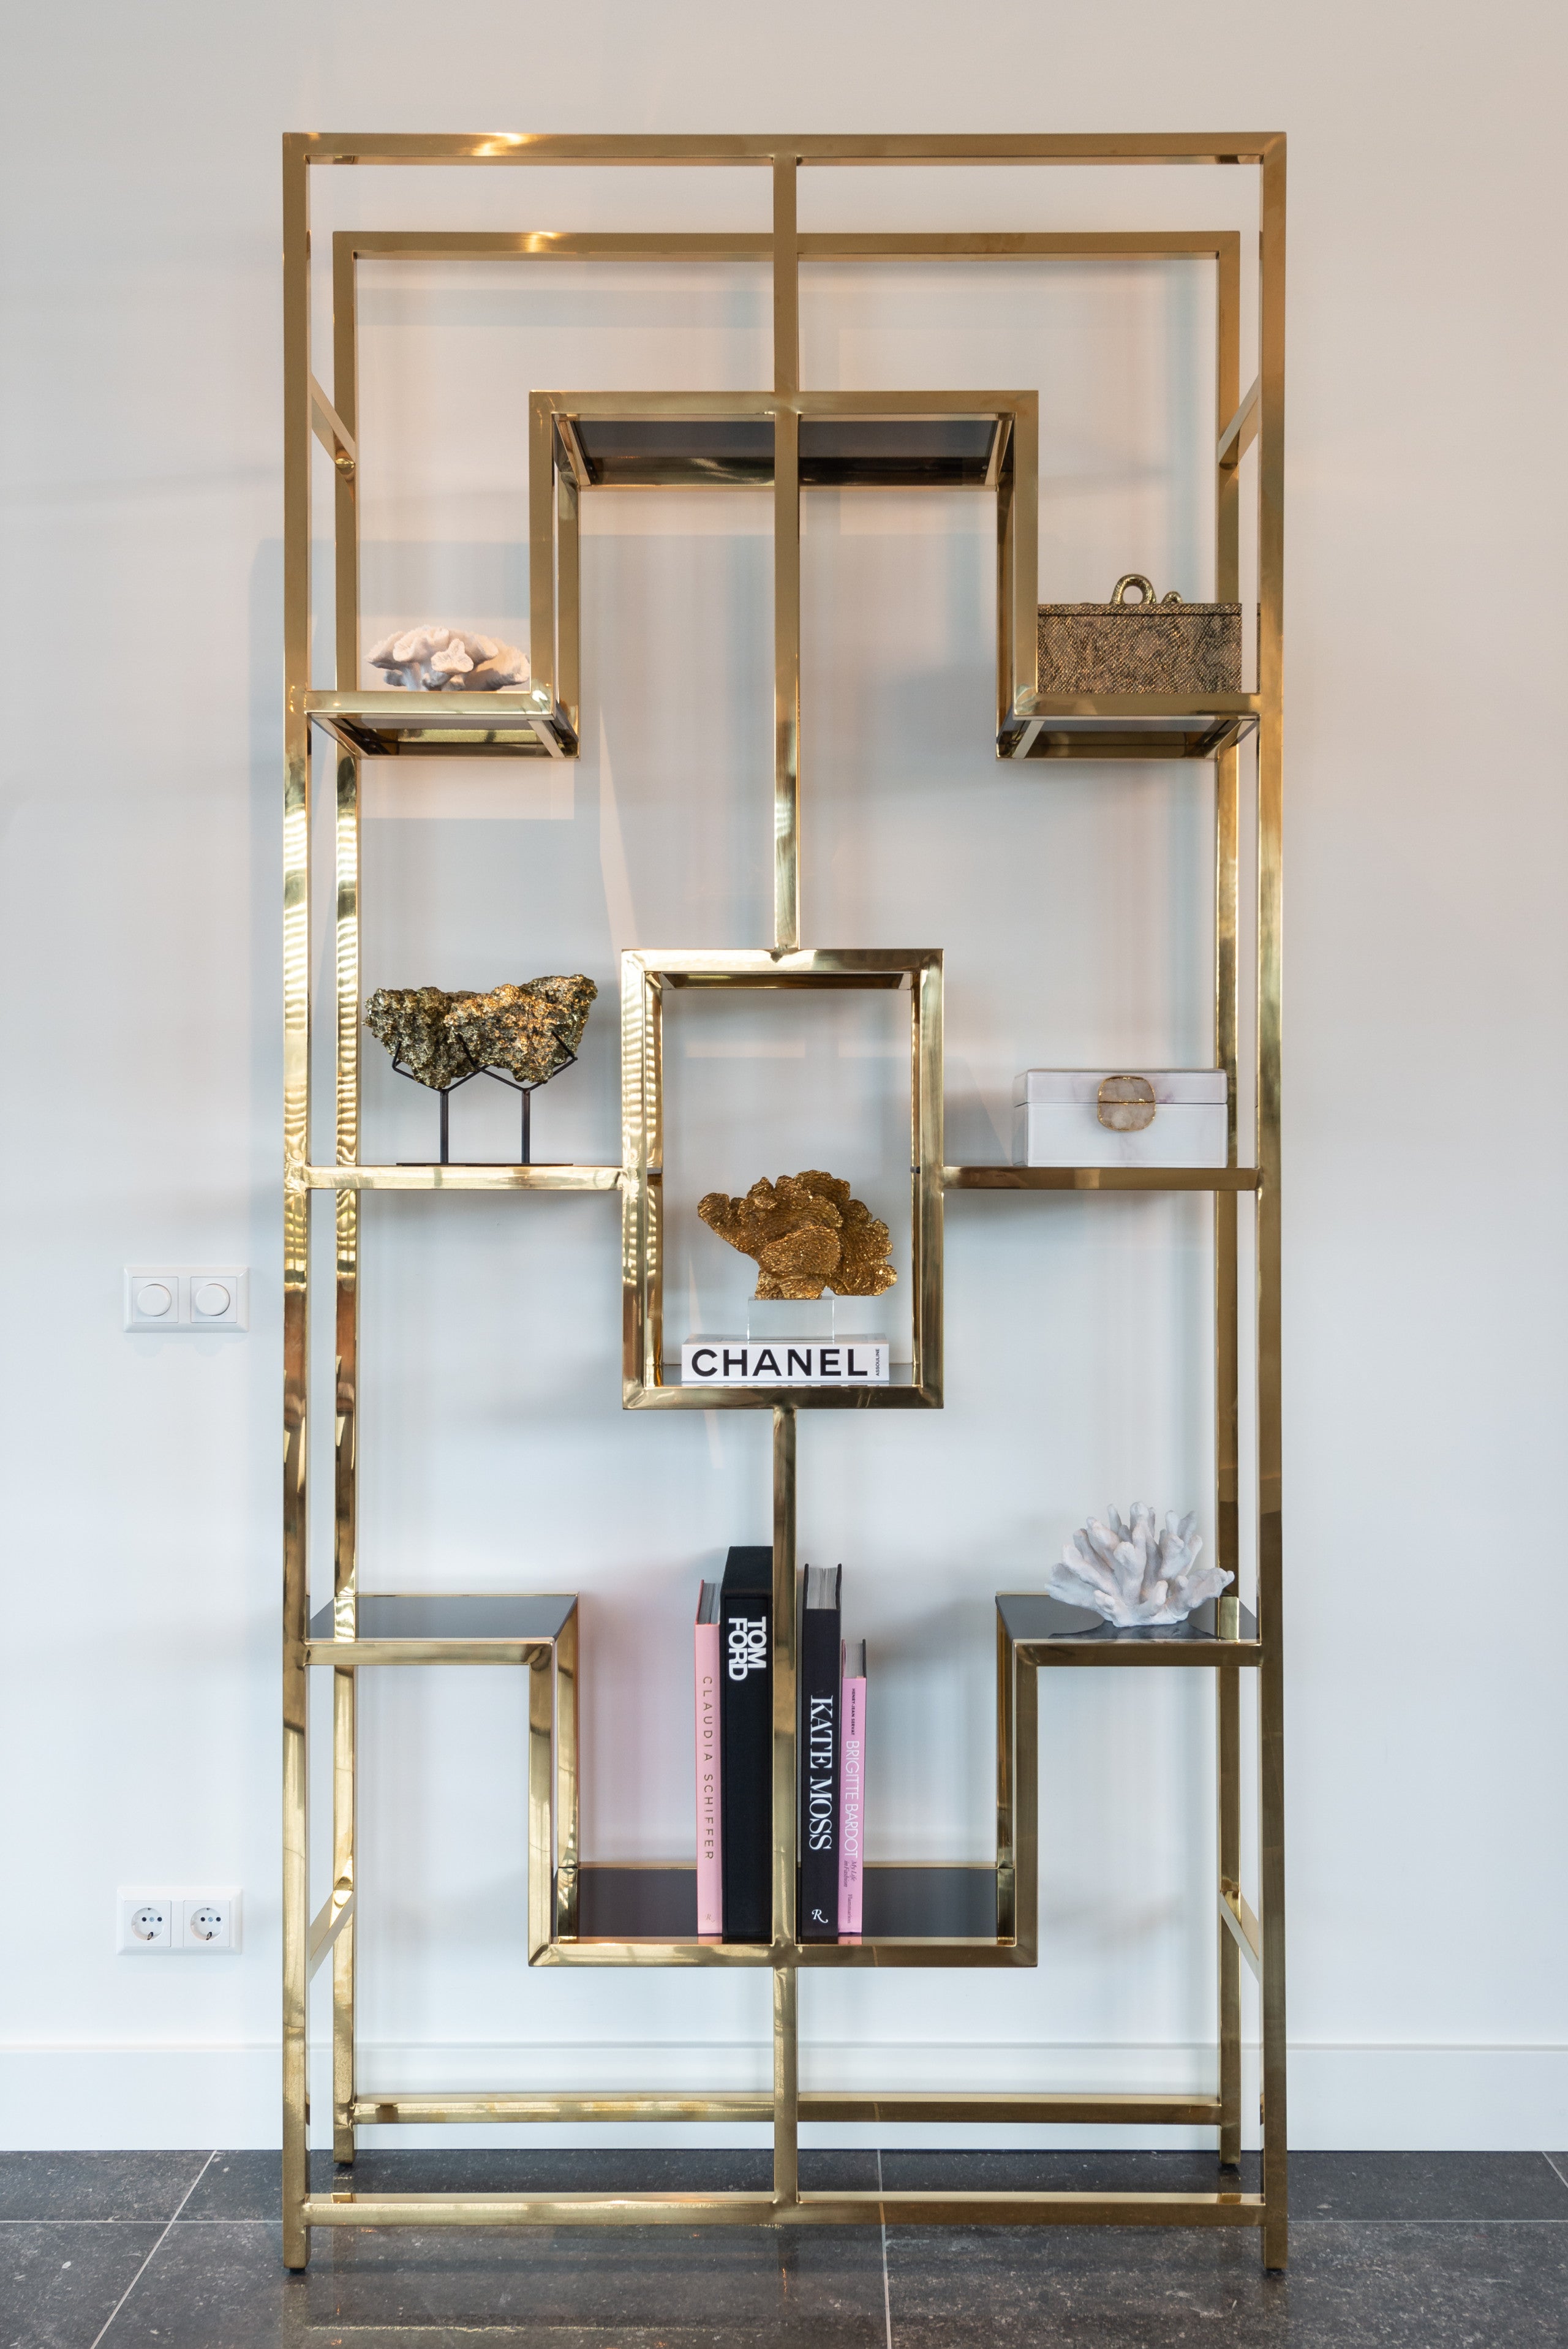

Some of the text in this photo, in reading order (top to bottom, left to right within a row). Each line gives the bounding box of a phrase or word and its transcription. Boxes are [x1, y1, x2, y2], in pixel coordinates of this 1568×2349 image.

[692, 1349, 868, 1376] CHANEL
[728, 1618, 748, 1681] FORD
[747, 1616, 767, 1668] TOM
[703, 1676, 714, 1860] CLAUDIA SCHIFFER
[809, 1695, 833, 1850] KATE MOSS
[845, 1740, 859, 1858] BRIGITTE BARDOT
[850, 1860, 857, 1871] My
[812, 1909, 828, 1923] R
